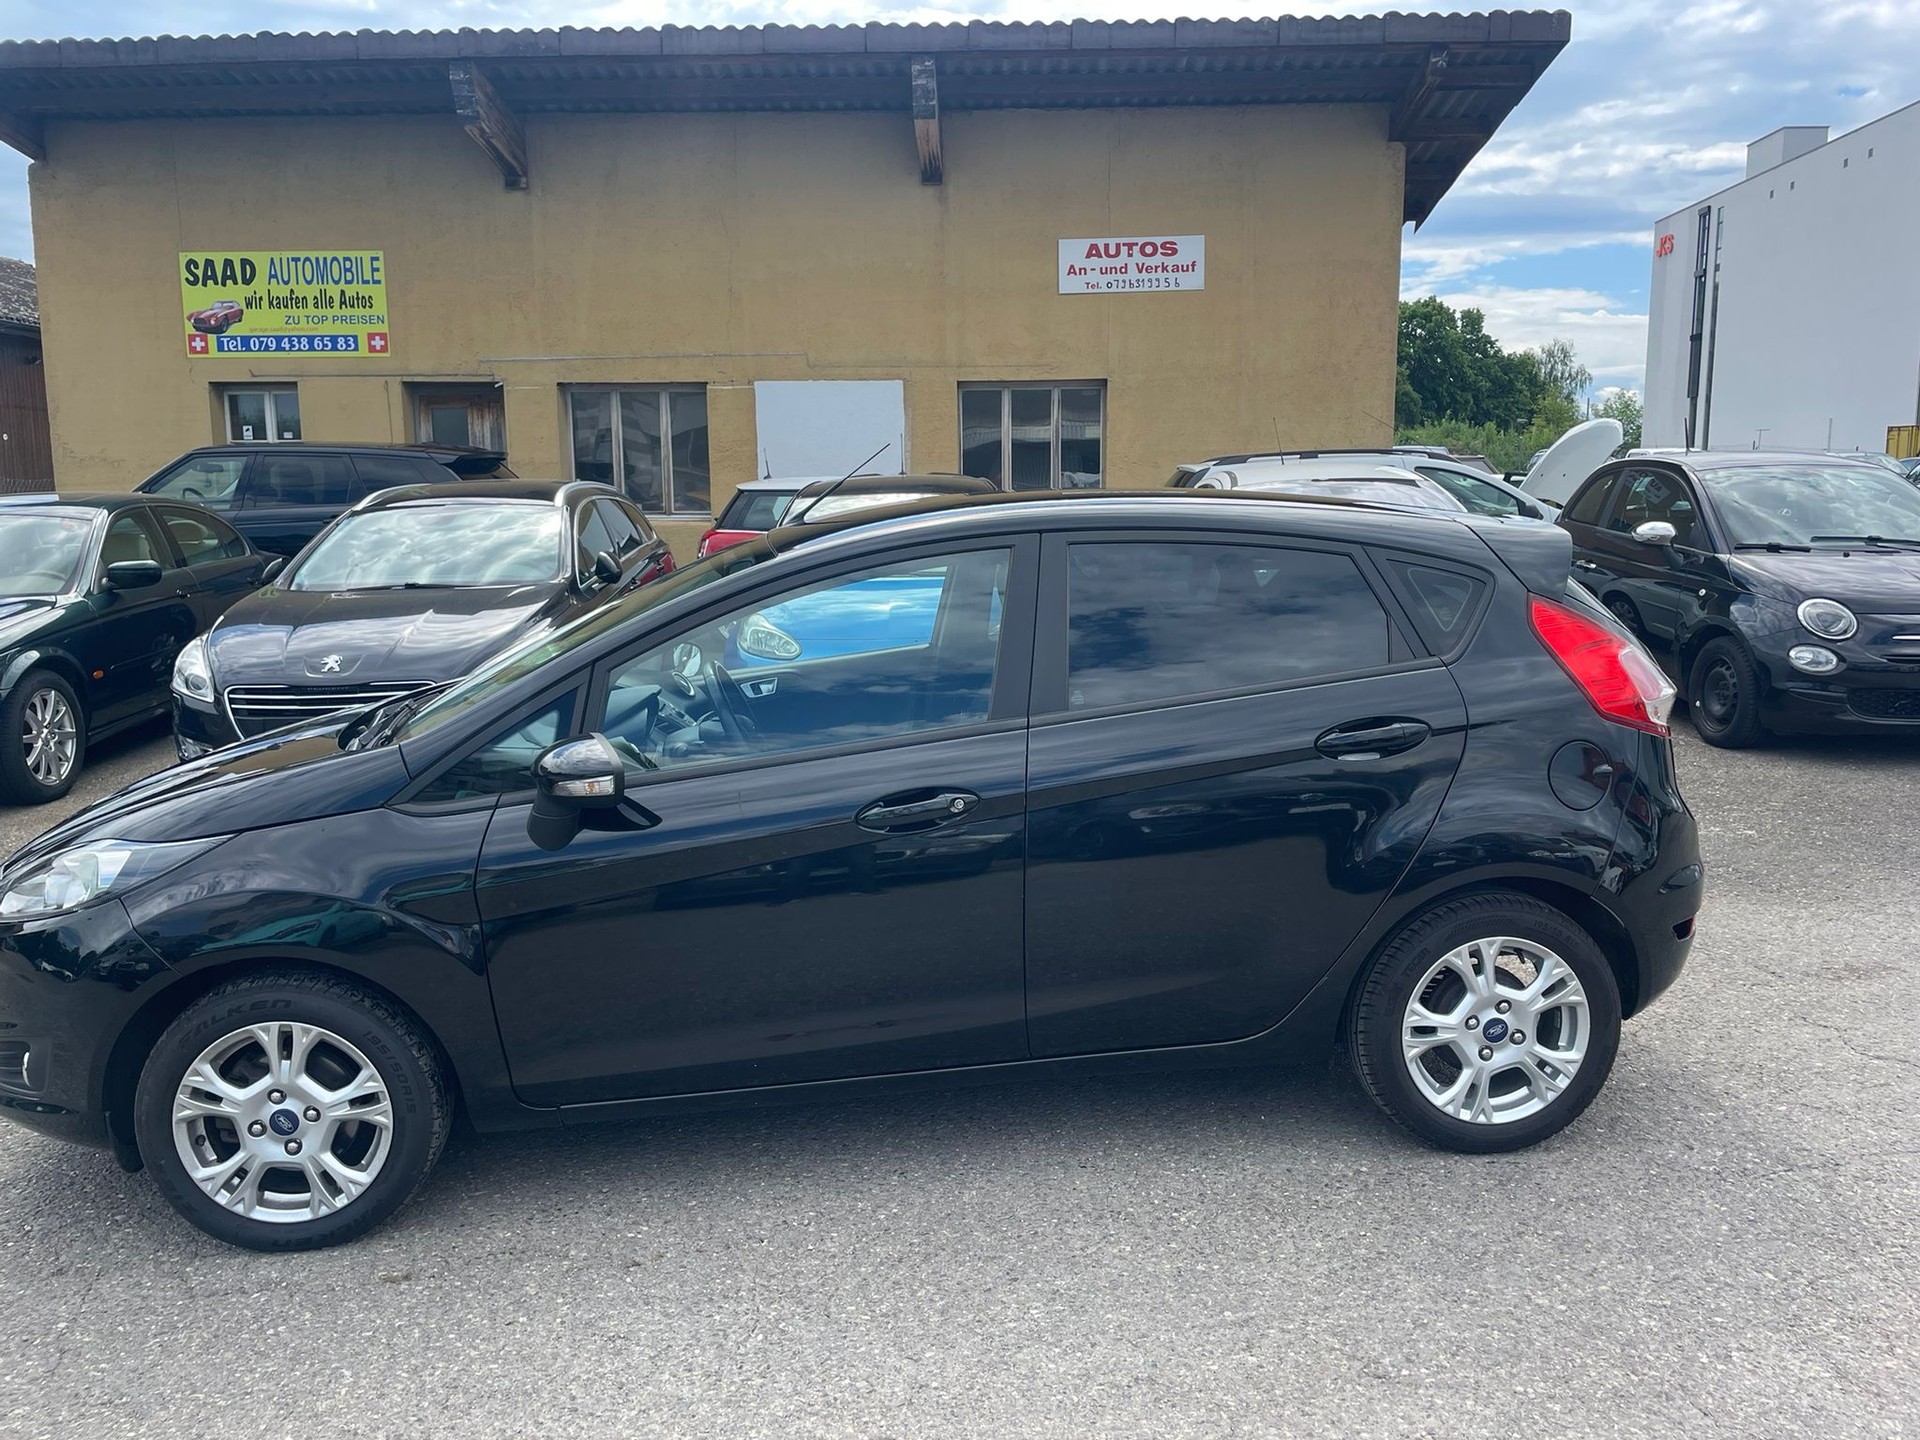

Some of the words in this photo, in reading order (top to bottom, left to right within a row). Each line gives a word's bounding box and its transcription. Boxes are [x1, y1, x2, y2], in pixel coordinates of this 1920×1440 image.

[1085, 241, 1179, 259] AUTOS
[184, 257, 257, 288] SAAD
[267, 255, 382, 286] AUTOMOBILE
[1135, 261, 1197, 274] Verkauf
[1085, 282, 1102, 290] Tel.
[244, 290, 263, 310] wir
[267, 288, 308, 310] kaufen
[312, 288, 335, 310] alle
[339, 288, 374, 310] Autos
[284, 315, 300, 326] ZU
[304, 315, 329, 325] TOP
[332, 314, 386, 325] PREISEN
[220, 337, 246, 352] Tel.
[250, 337, 277, 351] 079
[281, 337, 308, 351] 438
[313, 336, 332, 350] 65
[337, 336, 356, 350] 83
